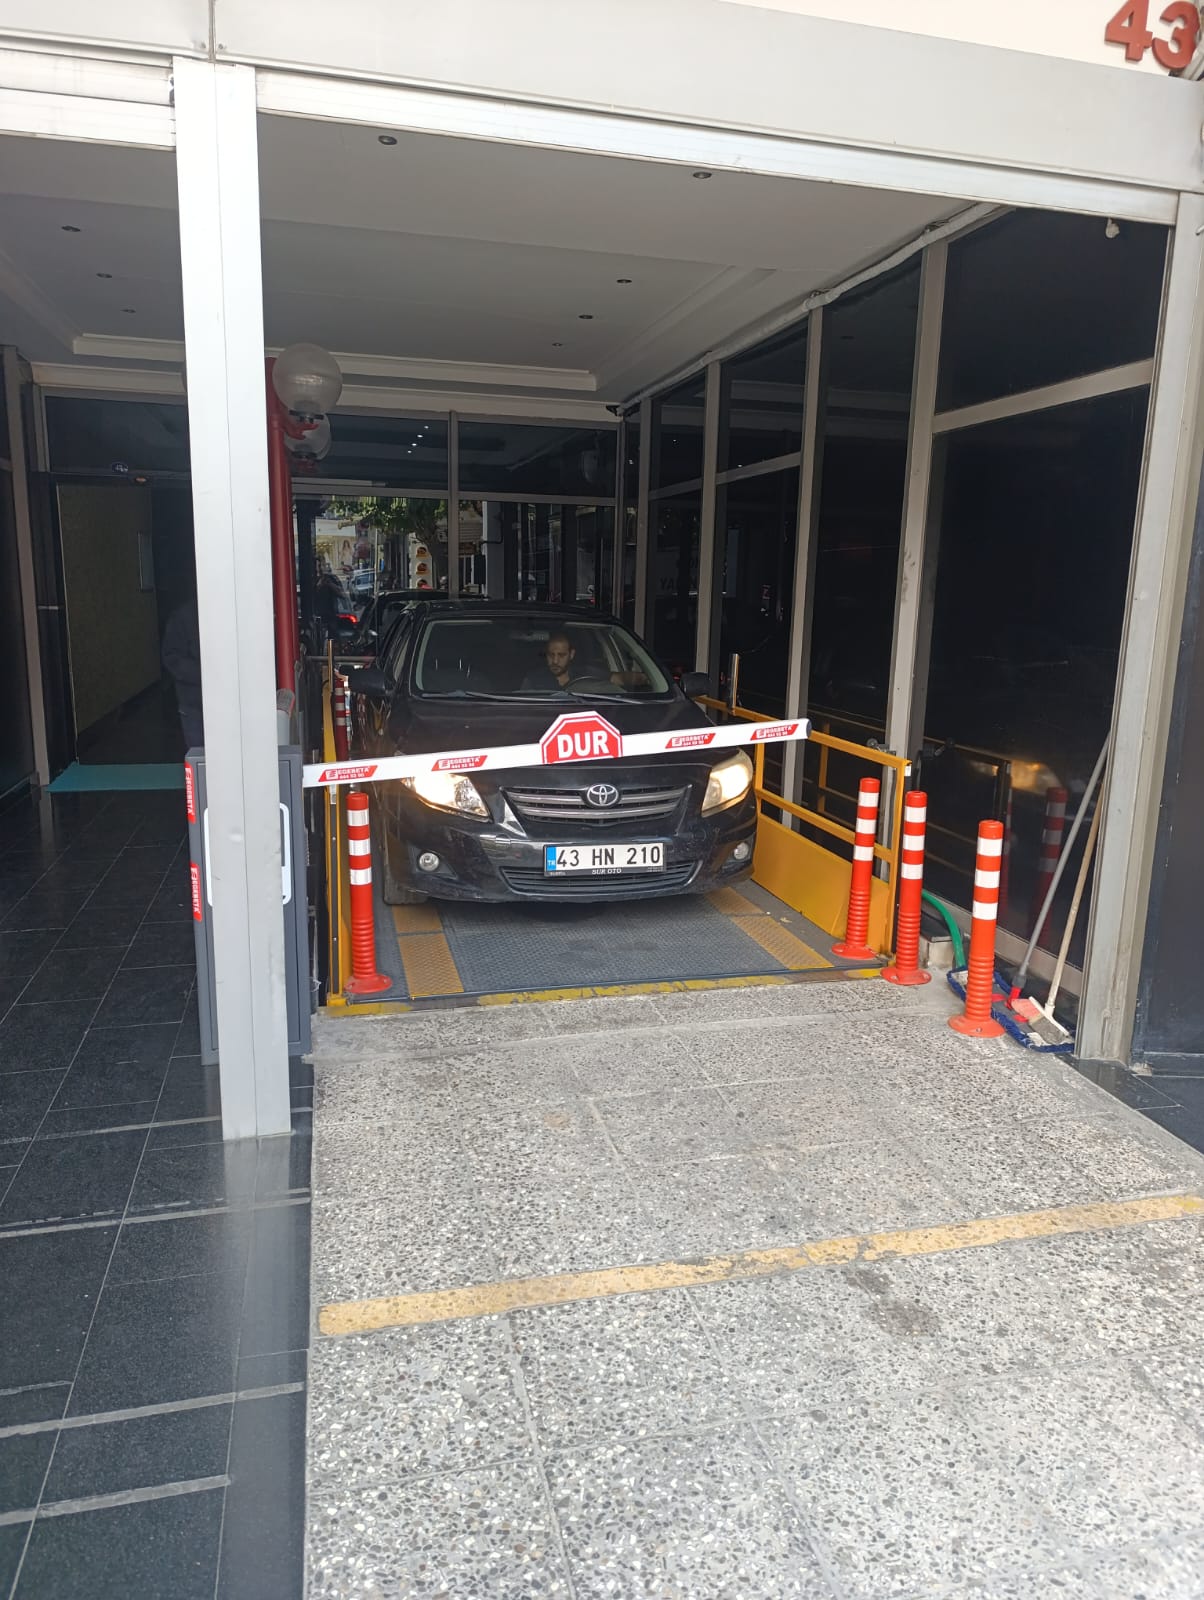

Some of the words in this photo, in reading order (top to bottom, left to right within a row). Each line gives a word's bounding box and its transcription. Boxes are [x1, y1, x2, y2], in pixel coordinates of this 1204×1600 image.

[1104, 0, 1200, 69] 43
[557, 730, 610, 759] DUR
[557, 849, 580, 867] 43
[592, 848, 614, 866] HN
[627, 846, 660, 864] 210
